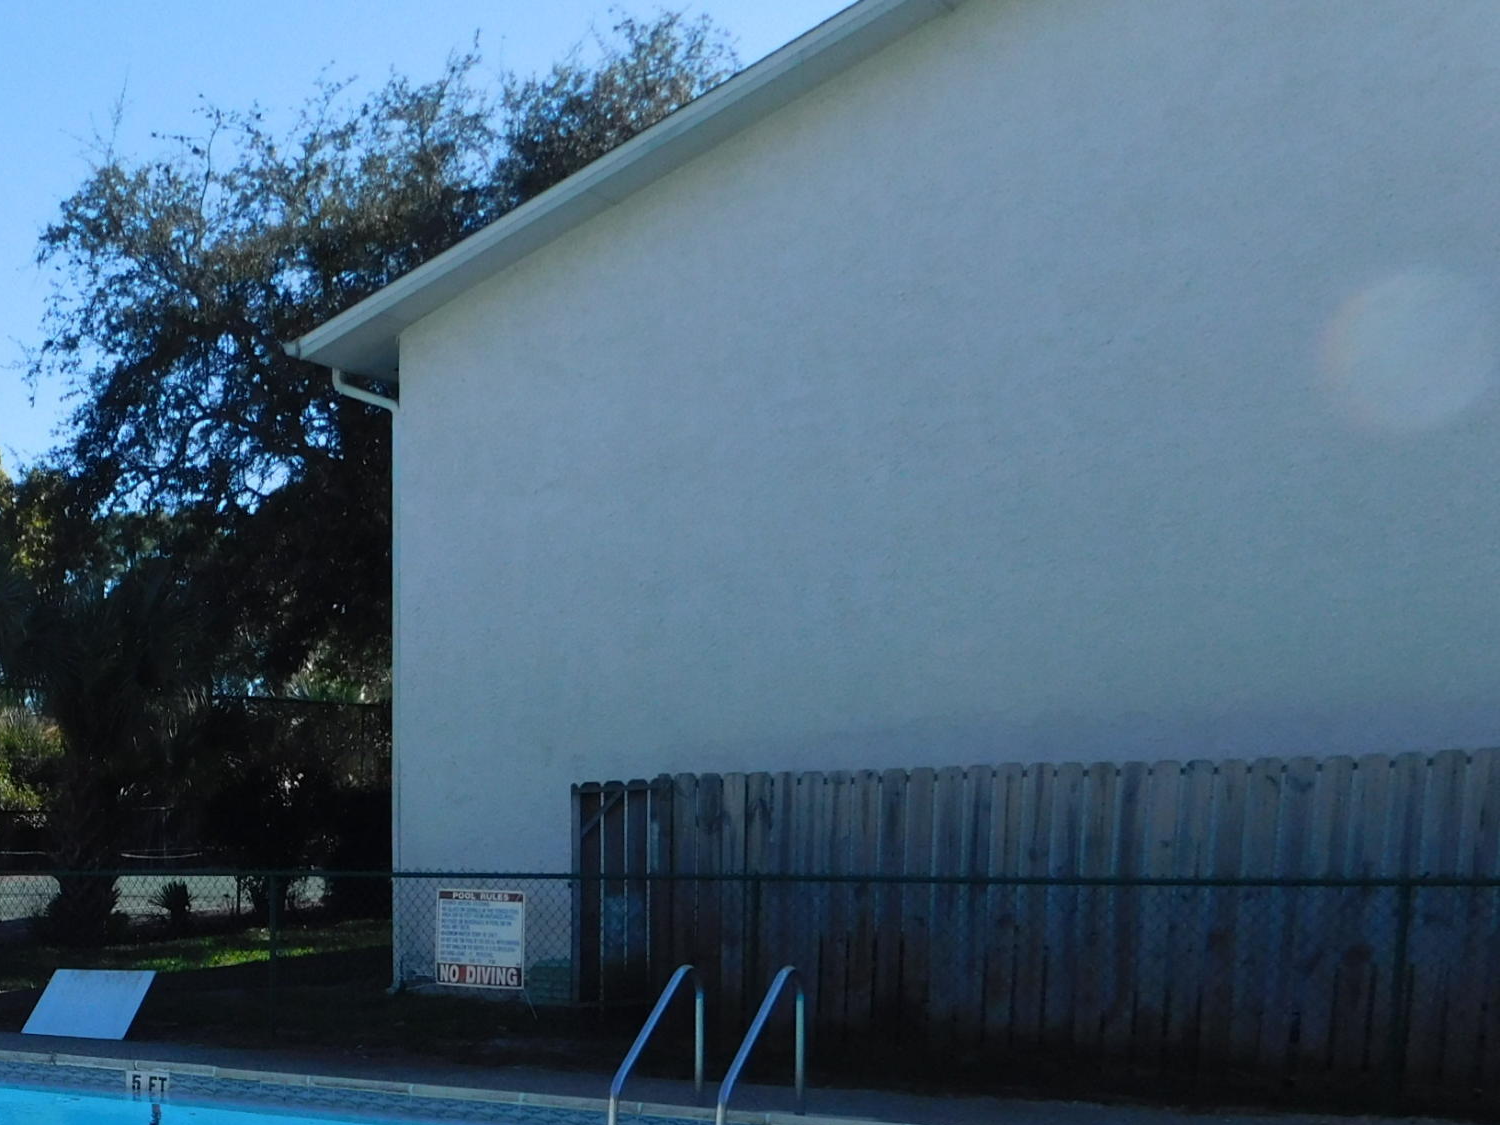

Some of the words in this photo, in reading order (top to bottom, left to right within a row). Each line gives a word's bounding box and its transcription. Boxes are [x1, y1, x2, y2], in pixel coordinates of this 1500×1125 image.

[452, 891, 476, 900] POOL
[480, 892, 509, 901] RULES
[440, 964, 460, 982] NO
[466, 965, 518, 986] DIVING
[132, 1074, 141, 1091] 5
[148, 1076, 167, 1092] FT
